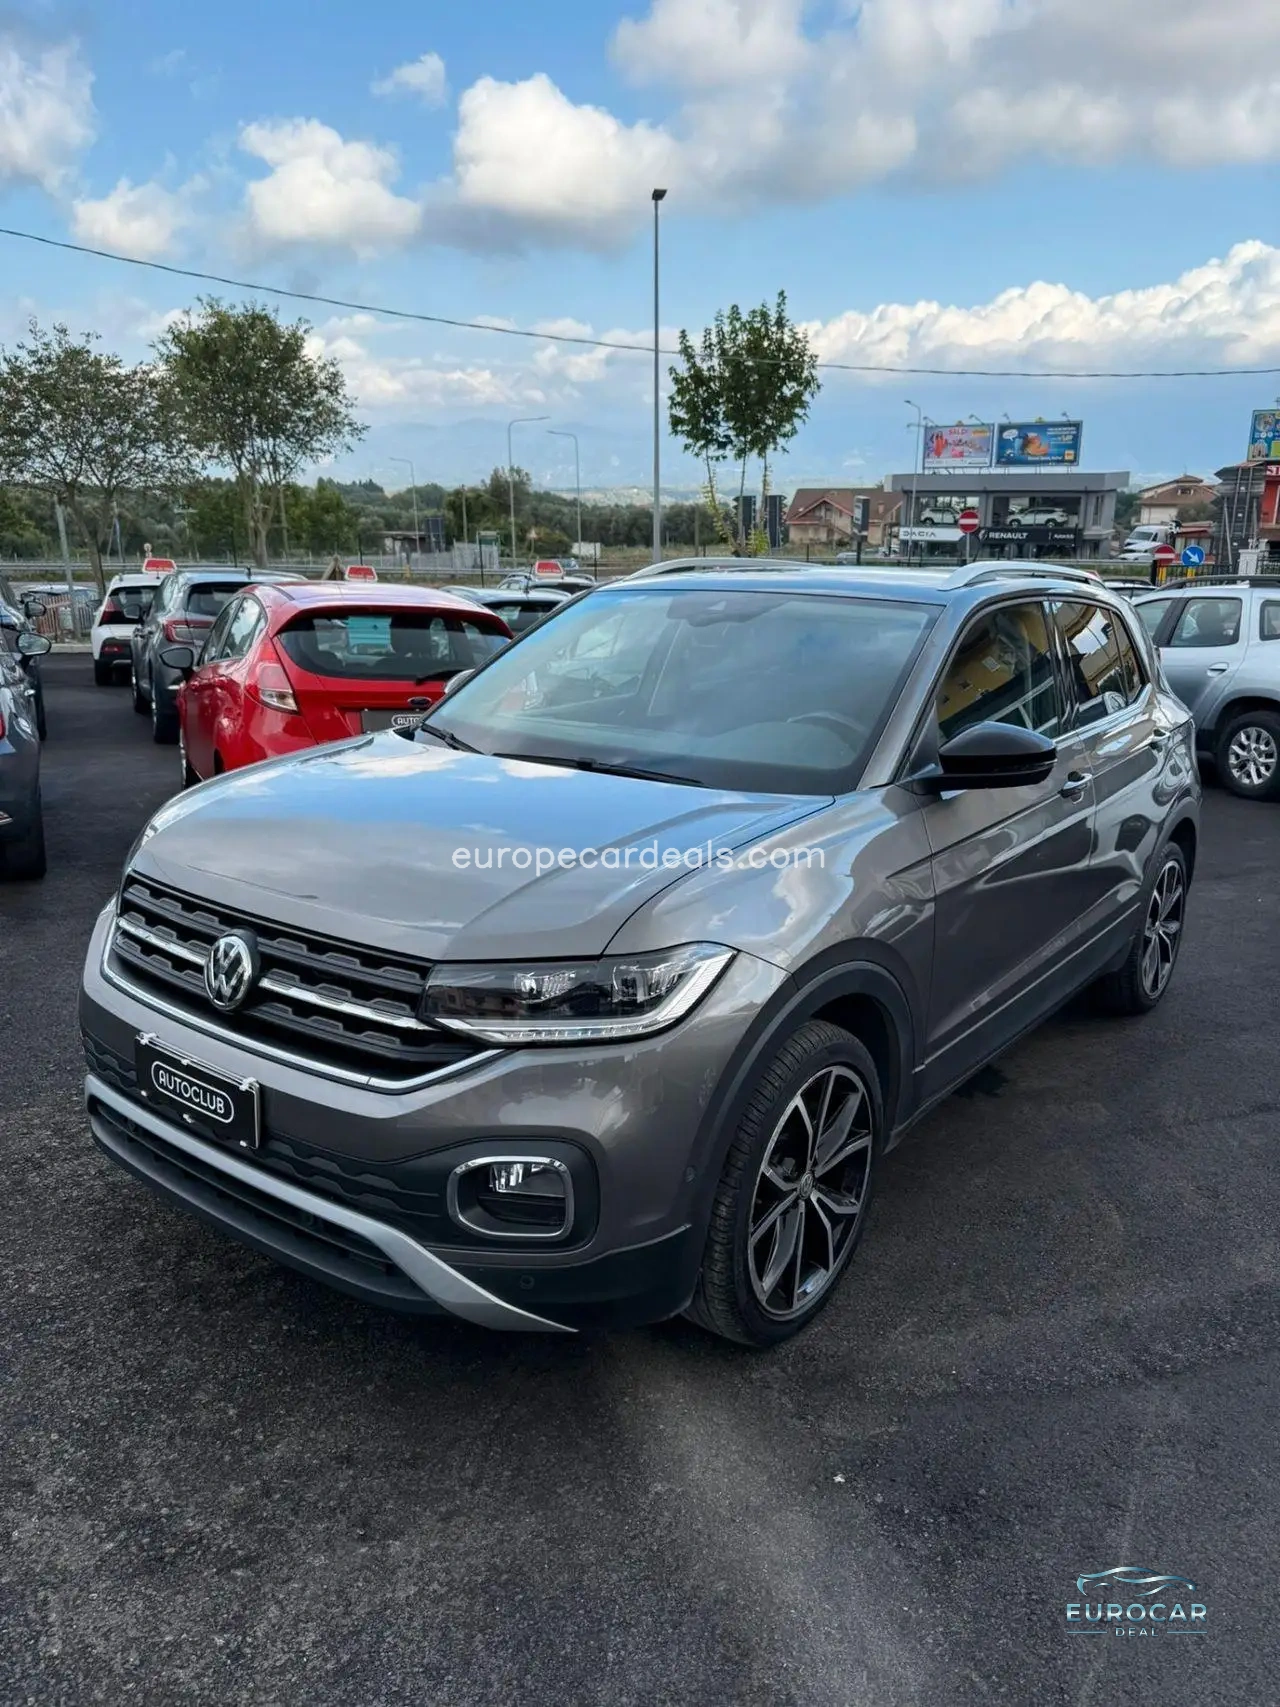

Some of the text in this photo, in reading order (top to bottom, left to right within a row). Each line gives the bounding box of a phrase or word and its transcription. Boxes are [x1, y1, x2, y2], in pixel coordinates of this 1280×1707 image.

[902, 530, 937, 538] DACIA
[989, 531, 1029, 539] RENAULT
[159, 1070, 225, 1114] AUTOCLUB
